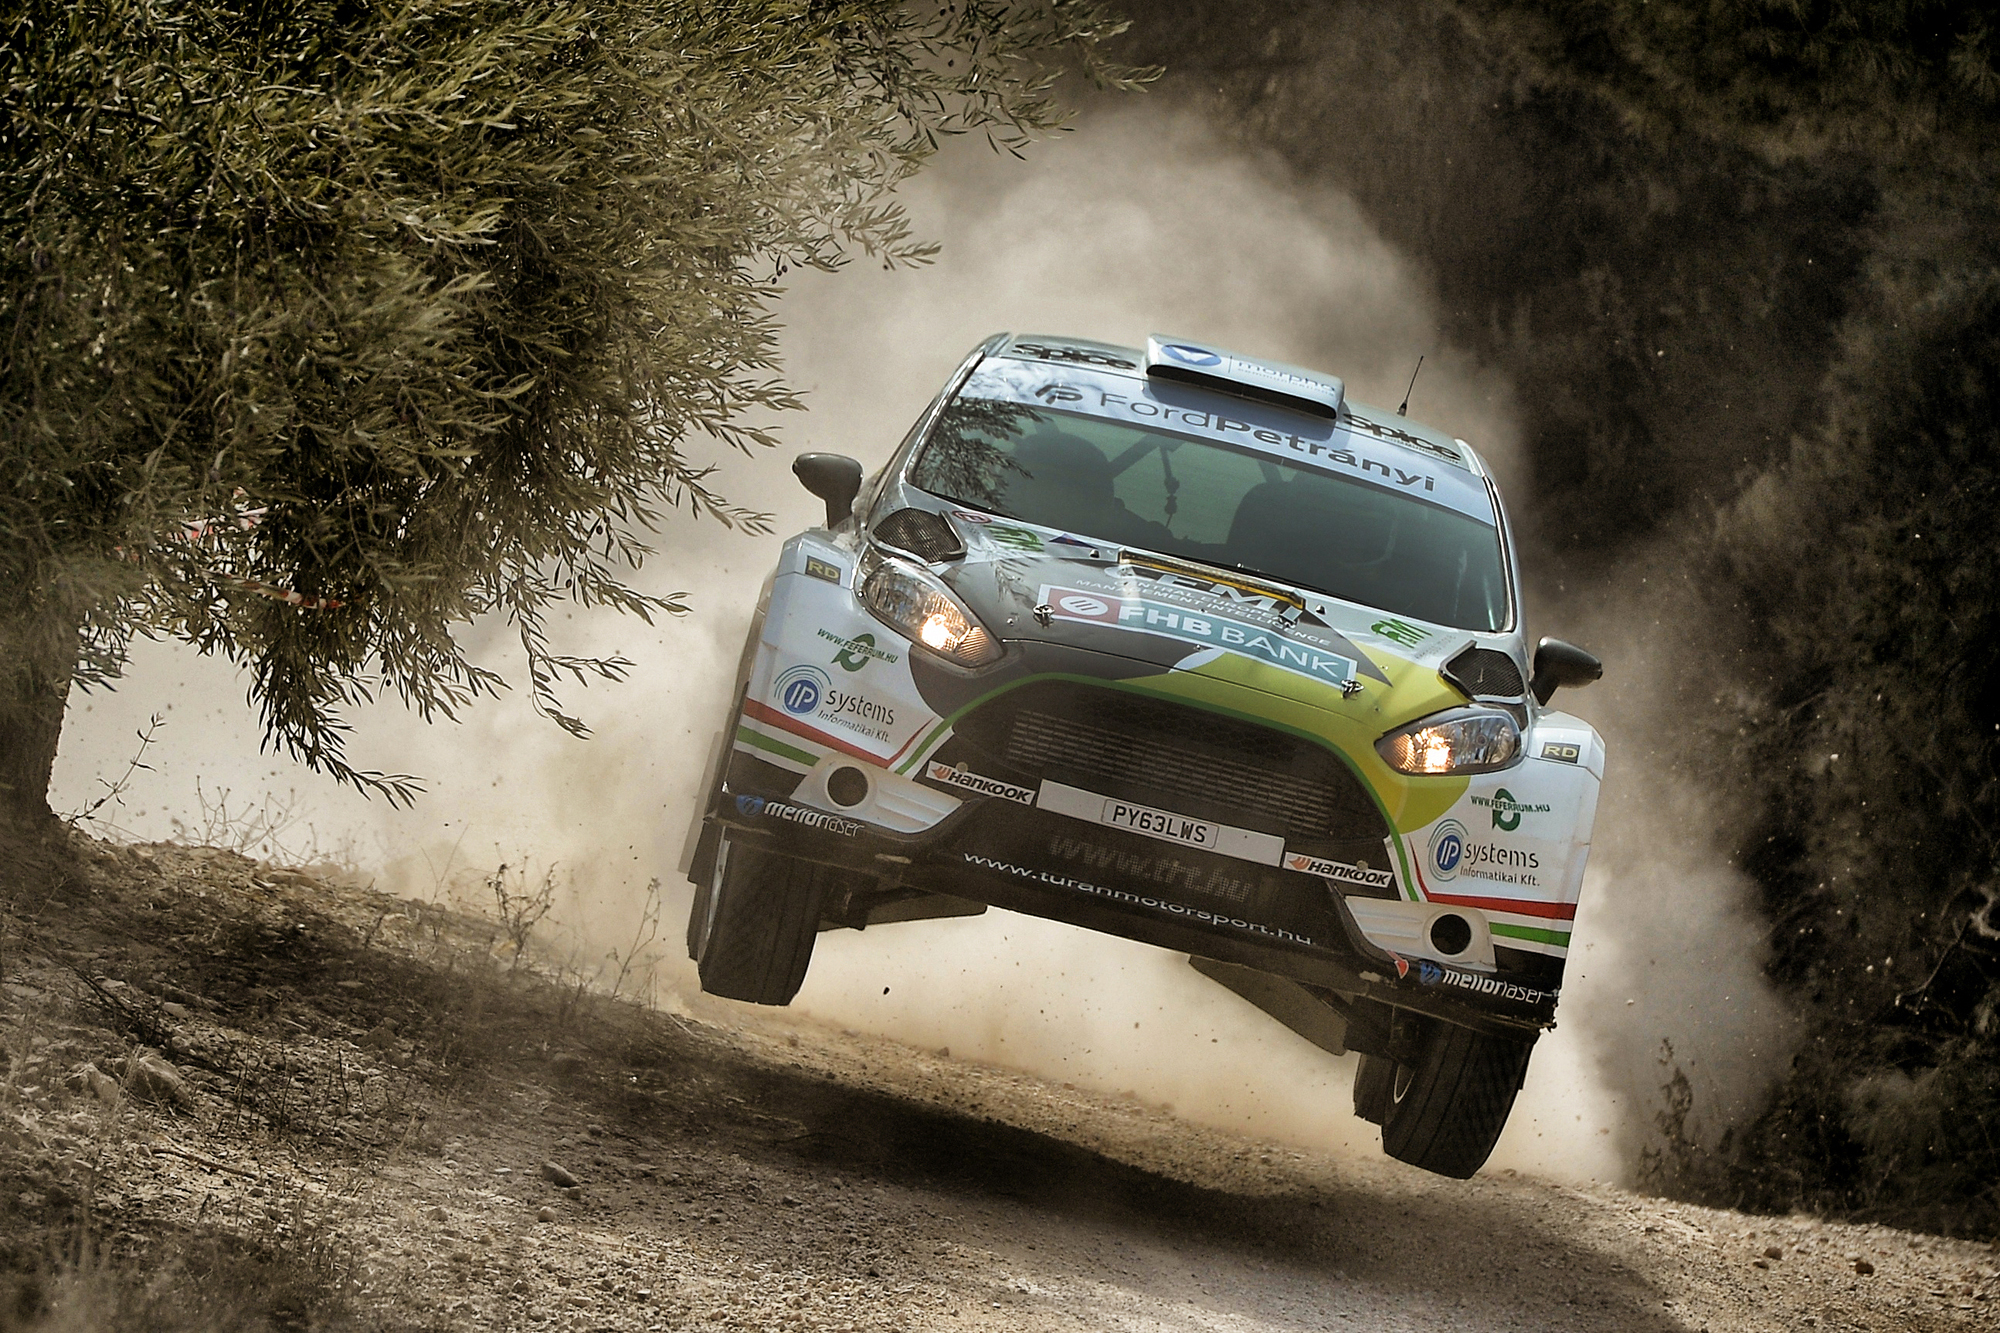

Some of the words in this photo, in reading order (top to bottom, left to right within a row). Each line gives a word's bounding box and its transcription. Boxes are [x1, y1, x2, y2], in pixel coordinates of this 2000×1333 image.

[1100, 392, 1435, 492] FordPetrányi
[1343, 412, 1461, 461] Spice
[807, 560, 839, 580] RD
[1206, 602, 1332, 646] INTELLIGENCE
[817, 628, 898, 664] WWW.FEFERRUM.HU
[1118, 606, 1212, 636] FHB
[1221, 626, 1339, 679] BANK
[825, 690, 895, 726] systems
[817, 709, 875, 739] Informatikai
[875, 730, 891, 744] Kft.
[1545, 745, 1578, 759] RD
[1471, 795, 1551, 813] WWW.FEFERRUM.HU
[1113, 805, 1207, 843] PY63LWS
[1464, 842, 1539, 868] systems
[1459, 865, 1518, 884] Informatikai
[1520, 873, 1540, 887] Kft.
[964, 852, 1312, 946] www.turanmotorsport.hu
